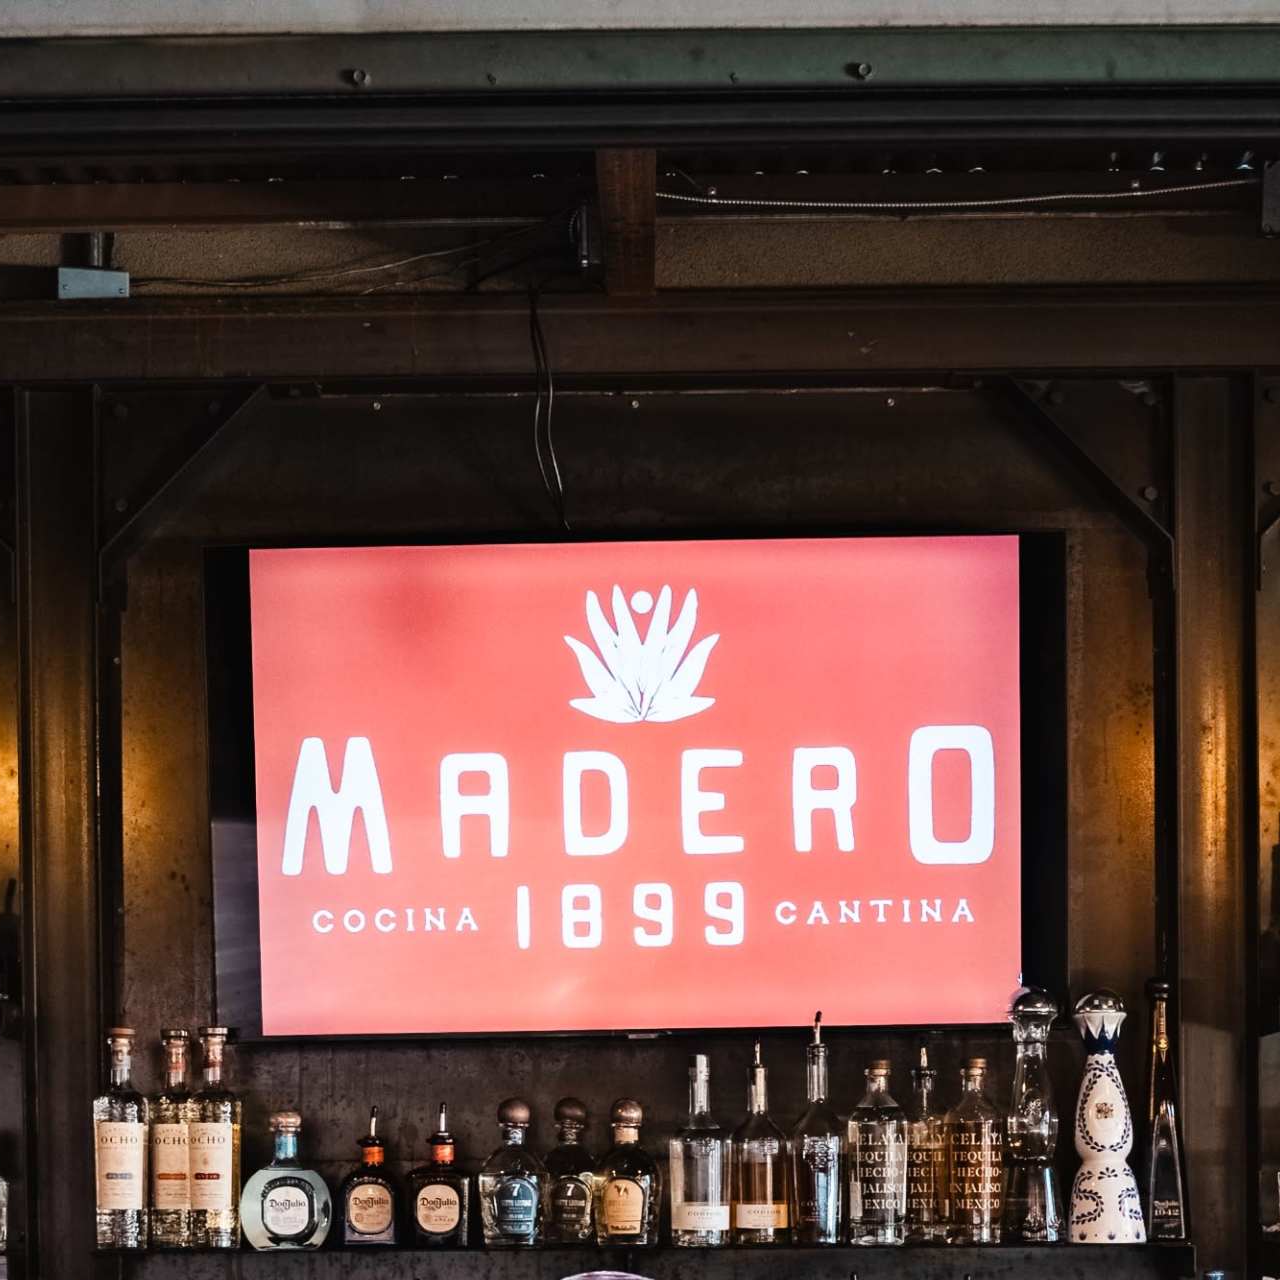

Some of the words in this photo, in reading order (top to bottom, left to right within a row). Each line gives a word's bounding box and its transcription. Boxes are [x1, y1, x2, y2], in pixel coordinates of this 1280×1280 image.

[281, 724, 995, 875] MADERO
[312, 906, 480, 934] COCINA
[516, 881, 745, 949] 1899
[775, 897, 976, 925] CANTINA
[100, 1136, 138, 1145] OCHO
[190, 1136, 226, 1145] OCHO
[512, 1183, 521, 1196] 7
[566, 1183, 575, 1196] 7
